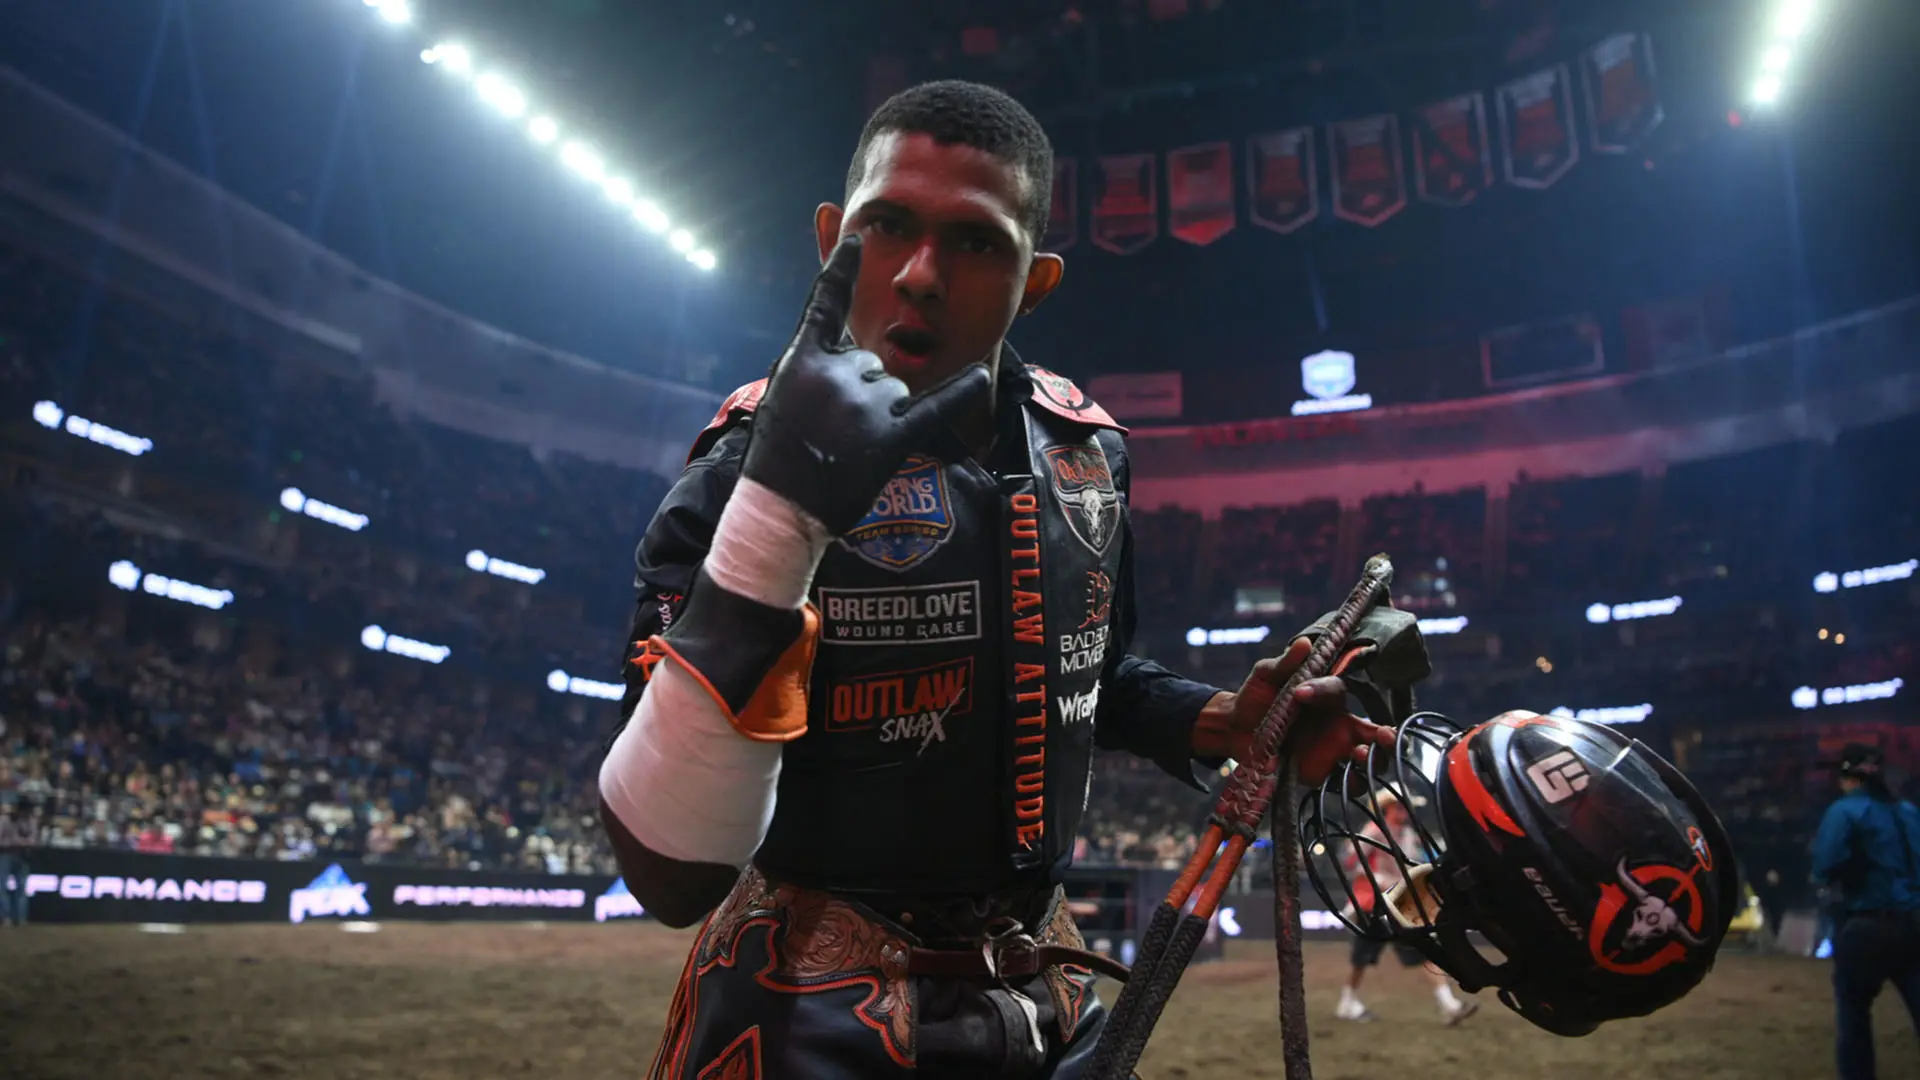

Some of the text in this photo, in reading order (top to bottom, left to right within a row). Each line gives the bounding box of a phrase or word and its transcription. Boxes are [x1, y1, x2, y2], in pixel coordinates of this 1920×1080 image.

[872, 493, 937, 517] ORLD
[828, 591, 972, 621] BREEDLOVE
[836, 620, 966, 638] WOUND CARE
[1010, 494, 1047, 846] OUTLAW ATTITUDE
[833, 666, 967, 722] OUTLAW
[24, 873, 267, 902] FORMANCE
